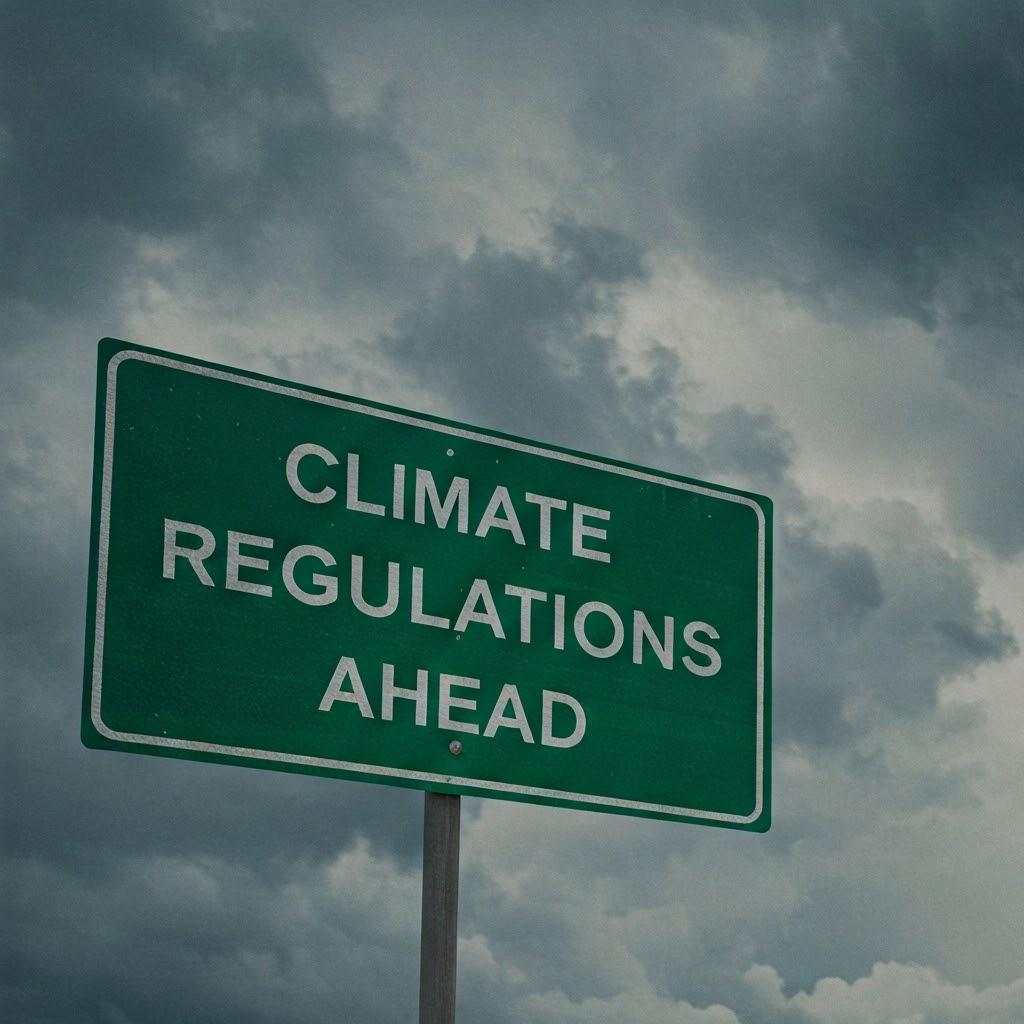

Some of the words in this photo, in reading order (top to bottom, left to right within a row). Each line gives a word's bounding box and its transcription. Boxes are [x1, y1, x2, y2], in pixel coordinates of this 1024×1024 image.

[285, 443, 612, 563] CLIMATE
[161, 518, 723, 677] REGULATIONS
[318, 655, 588, 749] AHEAD
